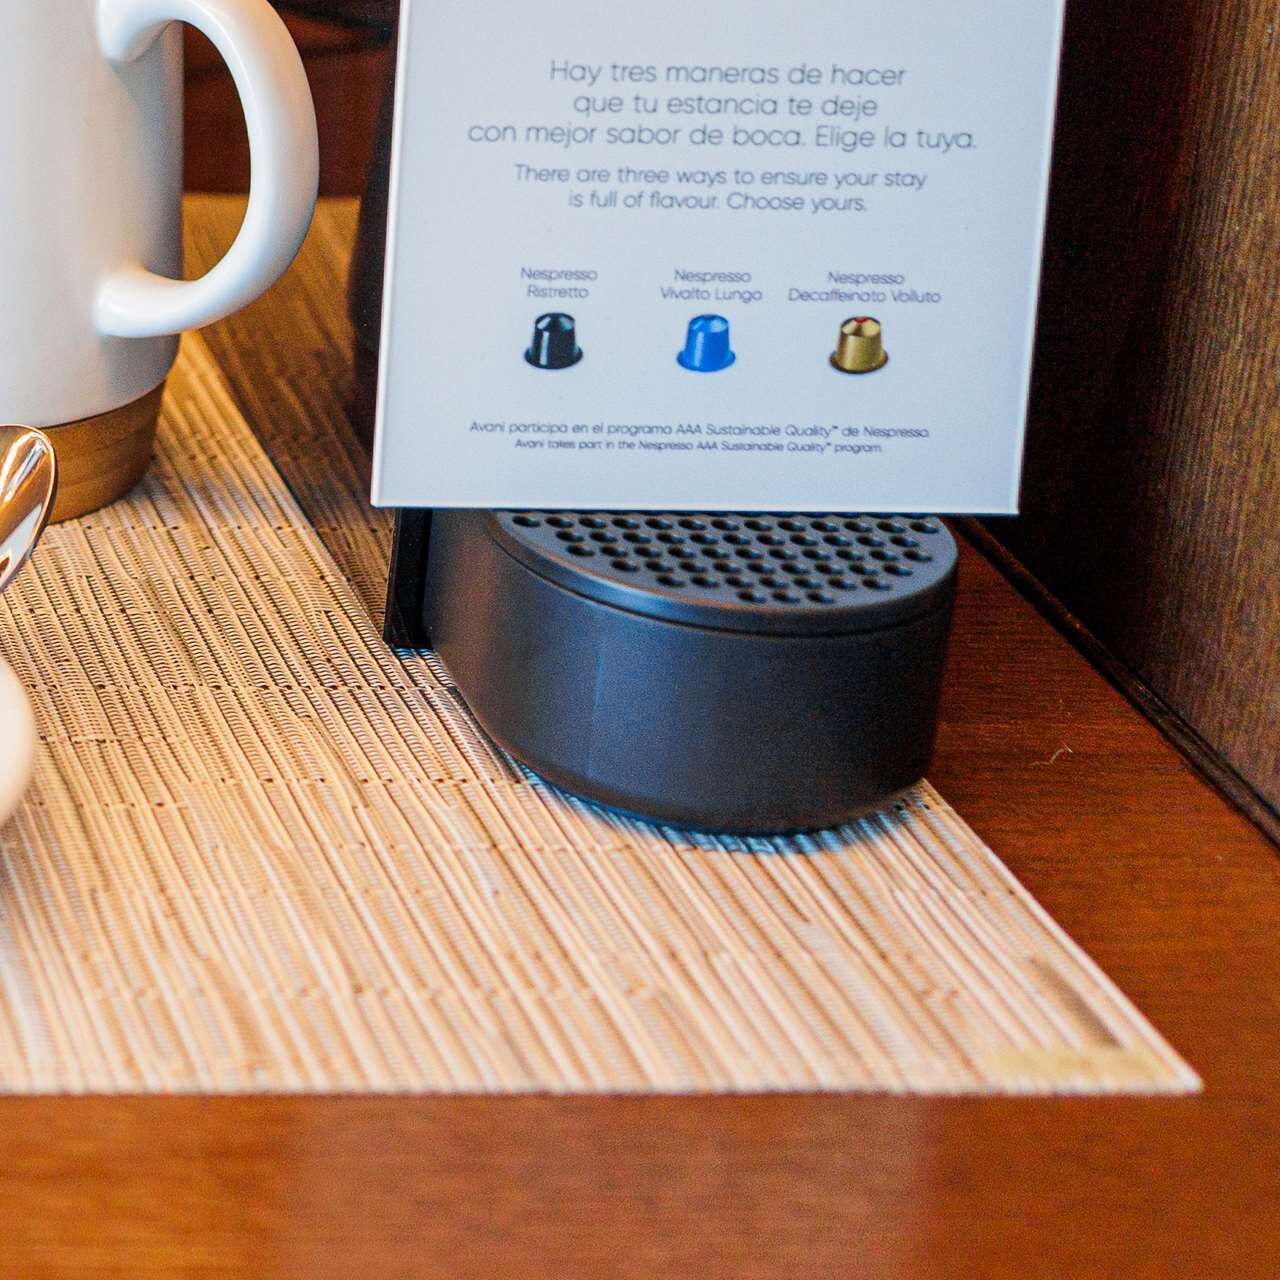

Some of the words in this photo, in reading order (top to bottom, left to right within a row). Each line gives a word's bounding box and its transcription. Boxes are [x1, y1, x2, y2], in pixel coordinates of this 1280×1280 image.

[550, 60, 602, 87] Hay
[611, 63, 658, 82] tres
[665, 66, 780, 84] maneras
[787, 64, 823, 85] de
[831, 64, 907, 86] hacer
[572, 95, 624, 117] que
[633, 95, 659, 114] tu
[666, 94, 778, 116] estancia
[788, 96, 813, 116] te
[820, 95, 878, 121] deje
[467, 124, 517, 143] con
[525, 123, 598, 148] mejor
[605, 123, 681, 145] sabor
[688, 124, 725, 146] de
[732, 125, 806, 147] boca.
[815, 124, 876, 153] Elige
[884, 126, 908, 148] la
[916, 128, 978, 153] tuya.
[514, 163, 570, 183] There
[575, 168, 610, 183] are
[617, 166, 670, 184] three
[676, 169, 728, 188] ways
[734, 169, 755, 185] to
[760, 171, 828, 186] ensure
[833, 172, 878, 190] your
[884, 171, 928, 191] stay
[568, 190, 583, 208] is
[590, 189, 618, 208] full
[623, 190, 644, 208] of
[649, 190, 720, 210] flavour.
[726, 192, 805, 210] Choose
[811, 195, 867, 214] yours.
[520, 267, 598, 283] Nespresso
[674, 269, 752, 284] Nespresso
[827, 271, 905, 286] Nespresso
[526, 283, 589, 299] Ristretto
[660, 286, 711, 301] Vivalto
[715, 287, 763, 304] Lungo
[787, 287, 887, 303] Decaffeinato
[890, 289, 942, 304] Volluto
[469, 421, 506, 434] Avani
[508, 422, 569, 436] participa
[571, 424, 589, 434] en
[592, 422, 605, 434] el
[606, 424, 673, 437] programa
[675, 423, 702, 435] AAA
[705, 423, 781, 437] Sustainable
[841, 425, 859, 438] de
[514, 438, 544, 449] Avani
[547, 438, 575, 450] takes
[578, 439, 603, 451] part
[617, 439, 636, 450] the
[639, 440, 693, 452] Nespresso
[696, 441, 718, 451] AAA
[720, 441, 784, 453] Sustainable
